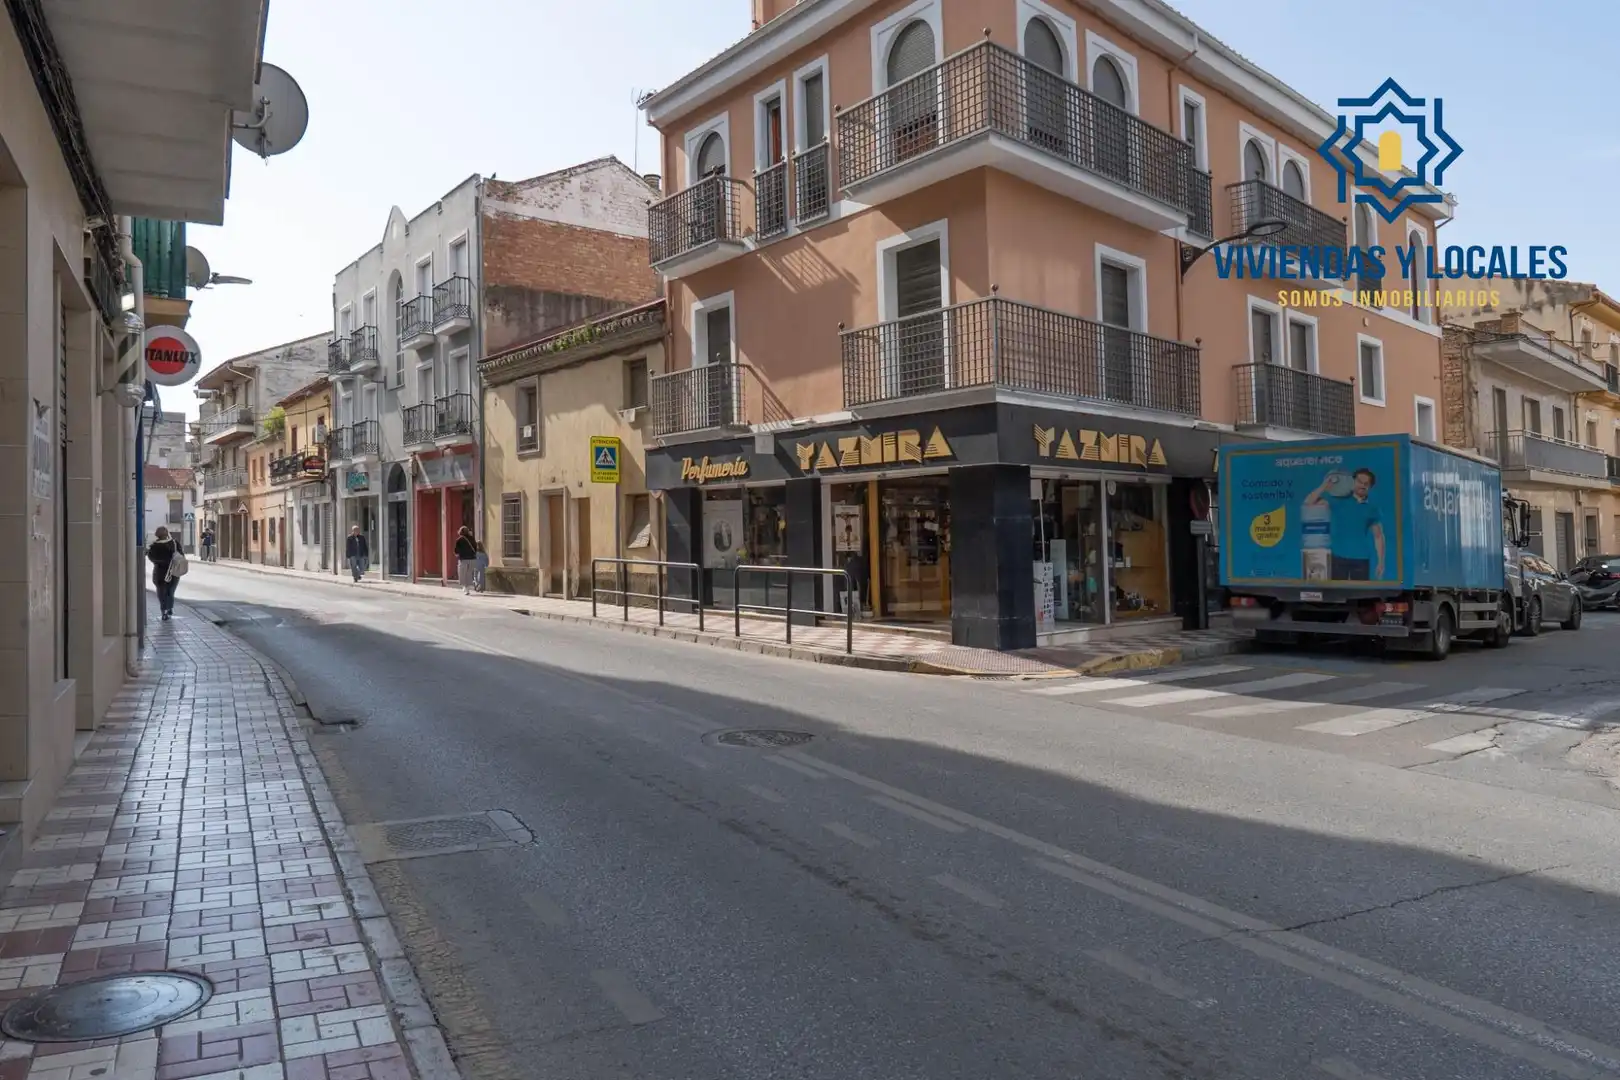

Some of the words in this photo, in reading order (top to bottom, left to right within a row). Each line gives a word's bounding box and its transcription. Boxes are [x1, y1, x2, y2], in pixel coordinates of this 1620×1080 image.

[796, 425, 953, 470] YAZMIRA
[1034, 423, 1168, 468] YAZMIRA
[681, 455, 749, 484] Perfumería
